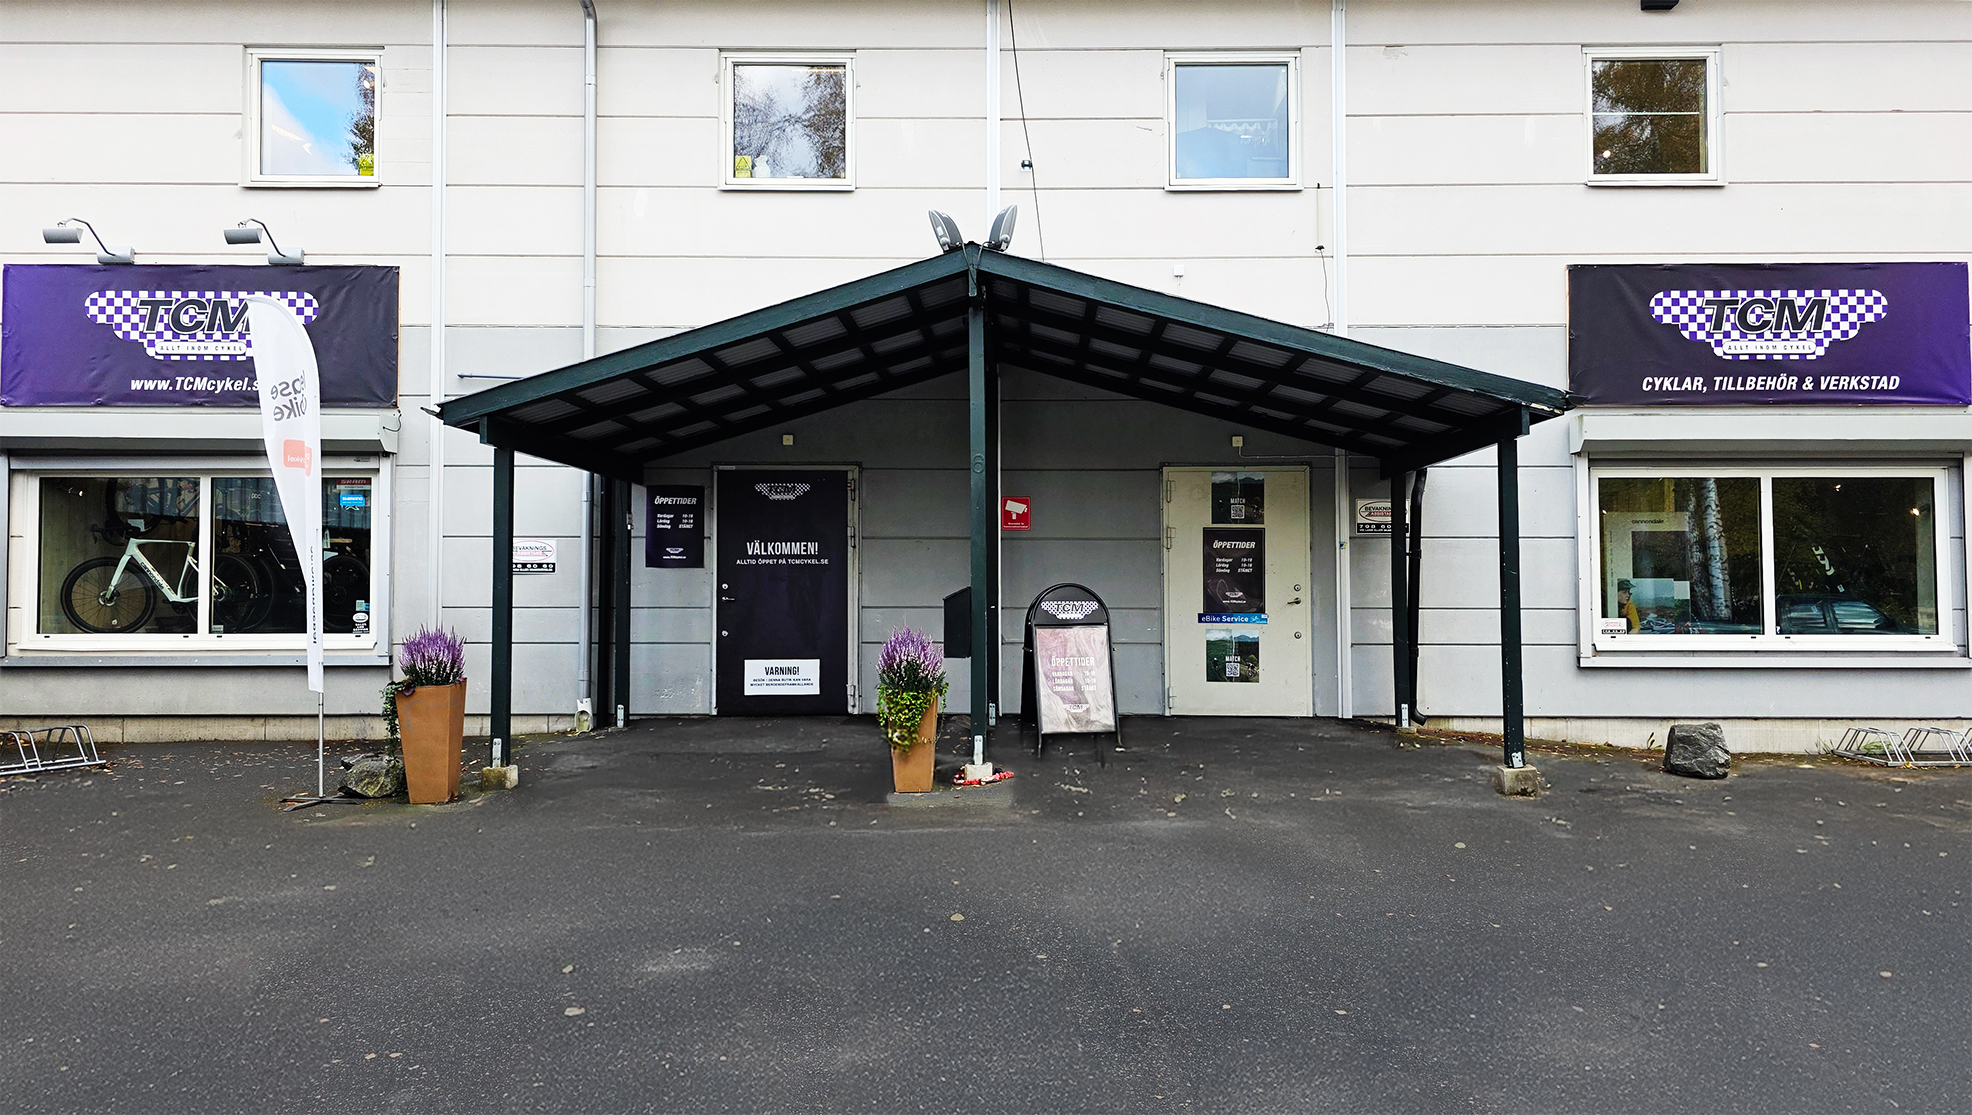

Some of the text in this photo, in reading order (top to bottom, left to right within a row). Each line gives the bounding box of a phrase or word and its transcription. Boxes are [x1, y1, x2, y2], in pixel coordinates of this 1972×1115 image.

[136, 297, 251, 335] TCM
[1701, 297, 1830, 334] TCM
[130, 377, 259, 394] www.TCMcykel.s
[1642, 373, 1900, 393] CYKLAR, TILLBEHÖR & VERKSTAD
[972, 453, 985, 474] 6
[653, 495, 697, 505] ÖPPETTIDER
[746, 540, 819, 556] VÄLKOMMEN!
[1213, 540, 1256, 549] ÖPPETTIDER
[1055, 603, 1084, 612] TCM
[1201, 614, 1249, 622] eBike Service
[1051, 656, 1095, 667] ÖPPETTIDER
[764, 666, 800, 676] VARNING!
